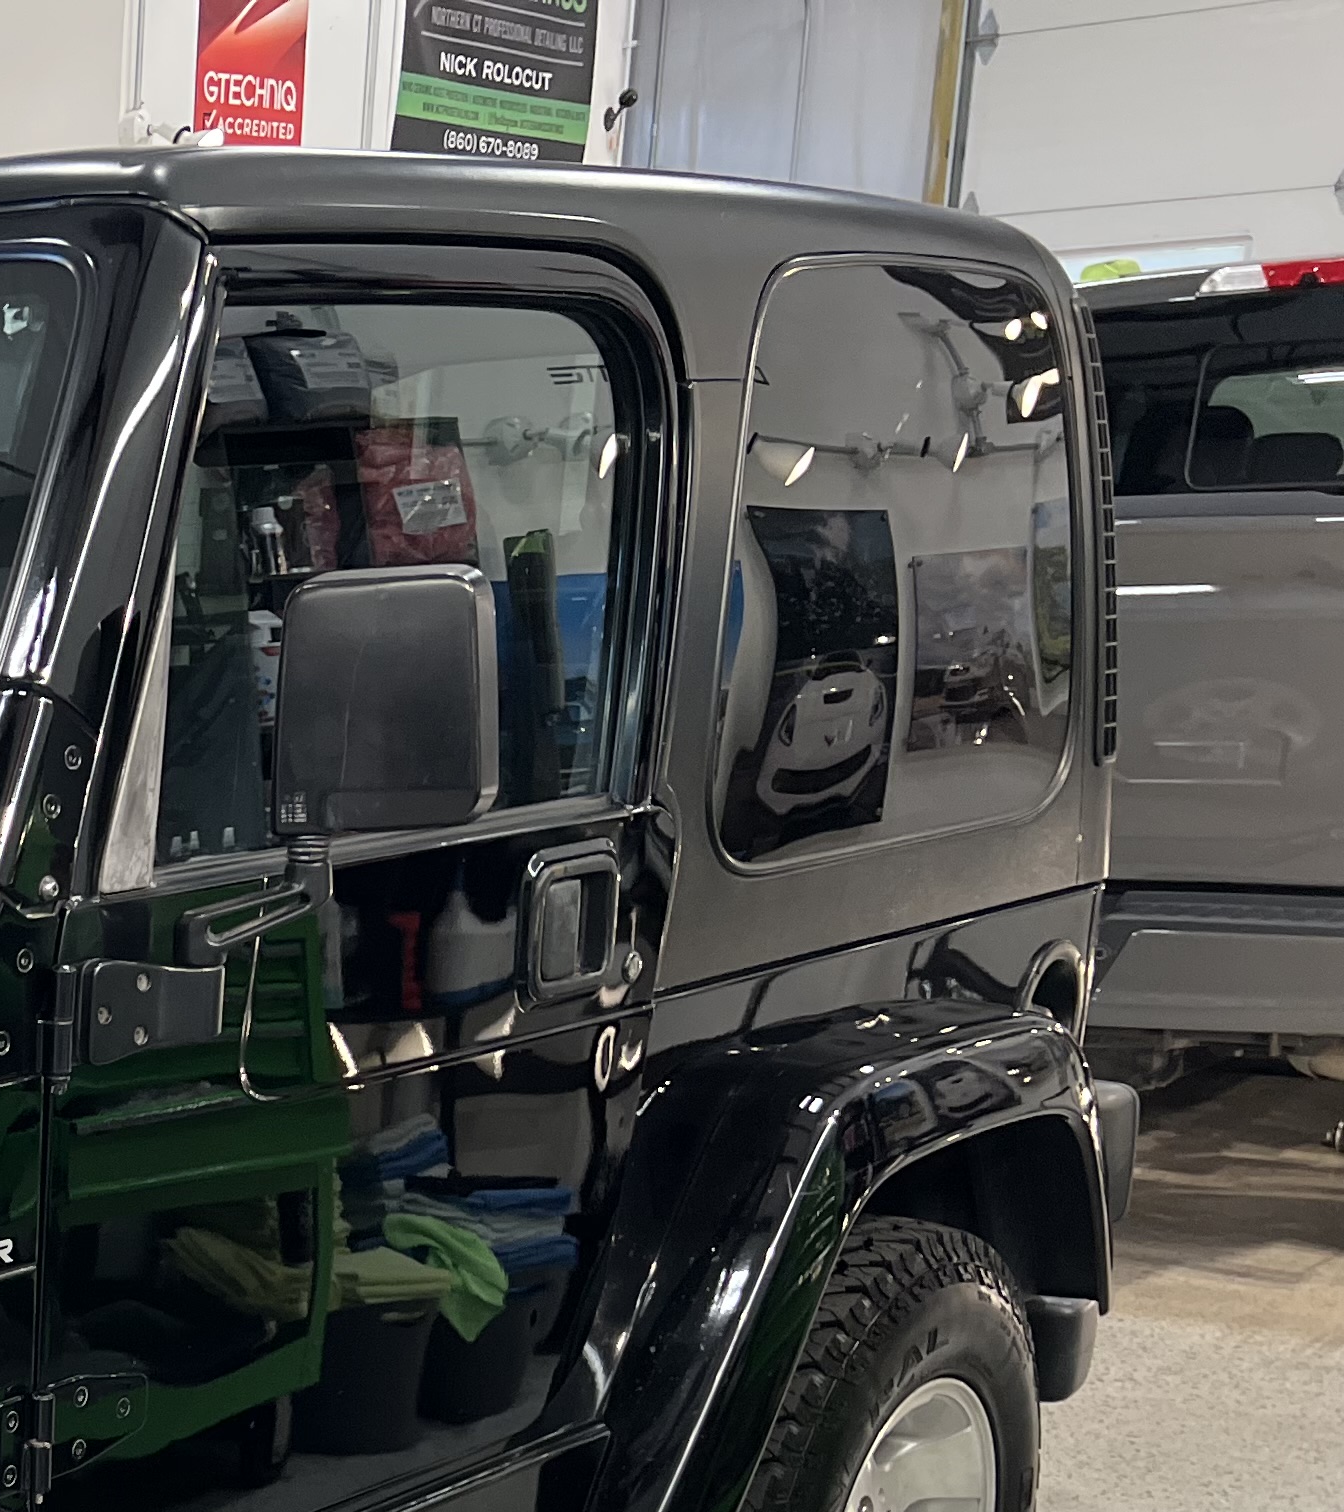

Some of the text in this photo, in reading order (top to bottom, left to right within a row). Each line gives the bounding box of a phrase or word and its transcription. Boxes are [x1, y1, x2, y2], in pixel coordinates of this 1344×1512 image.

[439, 51, 553, 91] NICK ROLOCUT
[203, 71, 297, 112] GTECHNIQ
[217, 116, 295, 140] ACCREDITED
[443, 128, 539, 160] (860) 670-8089
